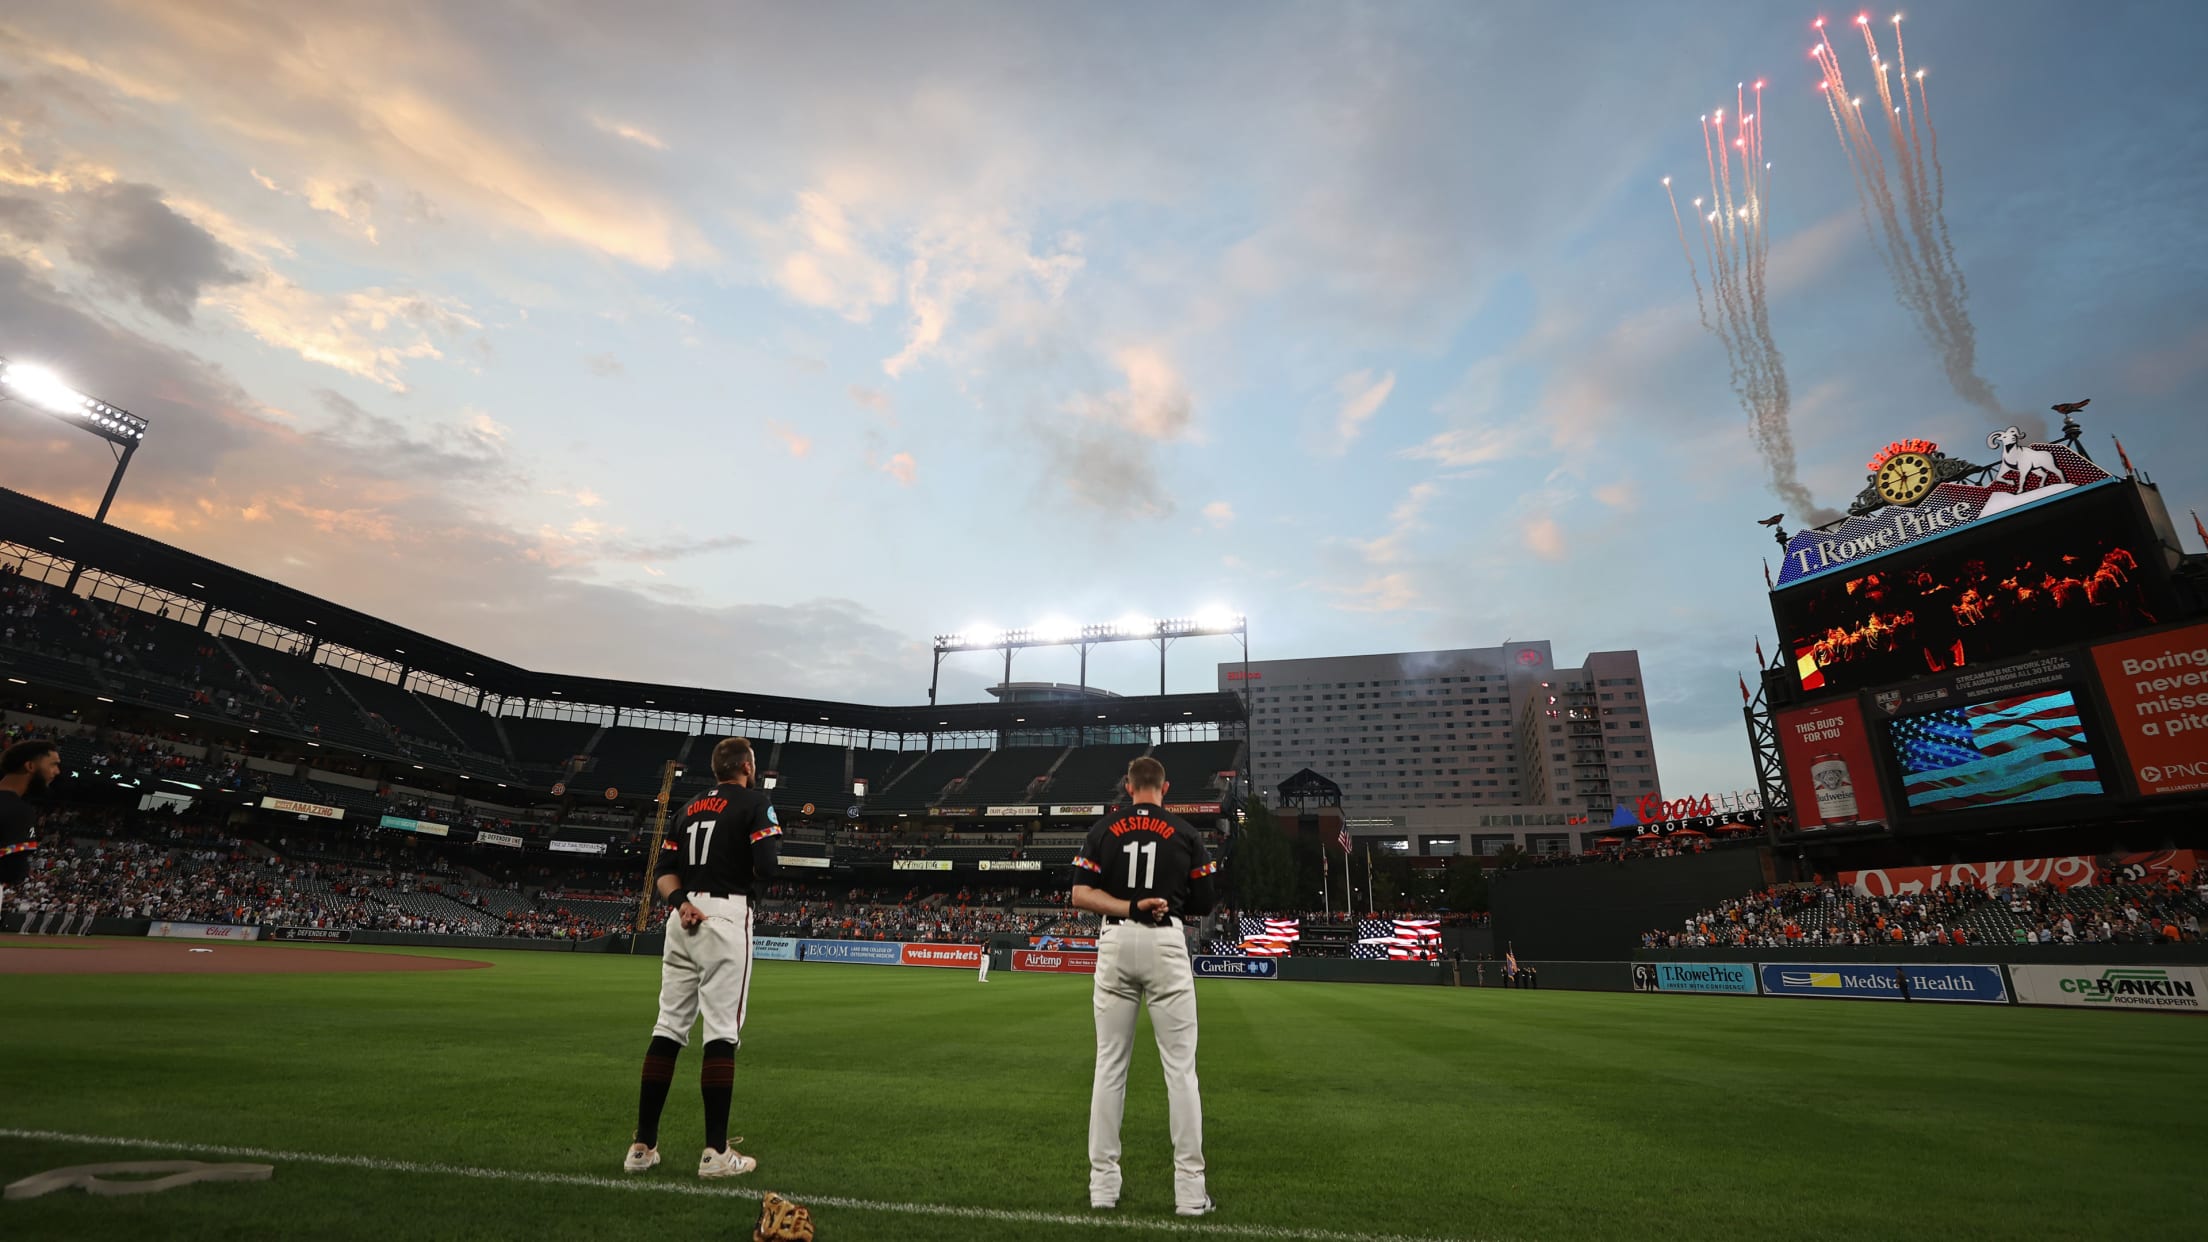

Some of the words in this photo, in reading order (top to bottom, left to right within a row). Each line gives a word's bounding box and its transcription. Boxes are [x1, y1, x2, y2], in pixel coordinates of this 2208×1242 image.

[1955, 672, 1986, 683] STREAM
[1985, 668, 2002, 678] MLB
[2001, 661, 2040, 675] NETWORK
[2040, 657, 2058, 667] 24/7
[2122, 648, 2208, 676] Boring
[1956, 680, 1974, 690] LIVE
[1975, 677, 1994, 687] AUDIO
[1995, 672, 2018, 684] FROM
[2018, 670, 2032, 678] ALL
[2032, 668, 2042, 676] 30
[2042, 661, 2071, 673] TEAMS
[2136, 670, 2208, 695] never
[1795, 721, 1816, 734] THIS
[1816, 716, 1844, 730] BUD'S
[2142, 722, 2160, 736] a
[1803, 731, 1821, 743] FOR
[1821, 727, 1841, 740] YOU
[2163, 761, 2208, 779] PNC
[687, 796, 729, 817] COWSER
[1635, 791, 1711, 824] Coors
[1109, 816, 1176, 840] WESTBURG
[1637, 820, 1688, 835] ROOF
[1705, 810, 1762, 827] DECK
[686, 820, 717, 866] 17
[1015, 860, 1041, 870] UNION
[1123, 840, 1157, 889] 11
[206, 927, 232, 937] Chill
[297, 929, 328, 938] DEFENDER
[765, 939, 789, 947] Breeze
[908, 949, 932, 959] weis
[933, 950, 978, 960] markets
[1025, 953, 1062, 966] Airtemp
[1201, 960, 1246, 973] CareFirst
[1912, 975, 1976, 991] Health
[2096, 979, 2195, 997] RANKIN
[2114, 997, 2156, 1005] ROOFING
[2157, 998, 2199, 1007] EXPERTS
